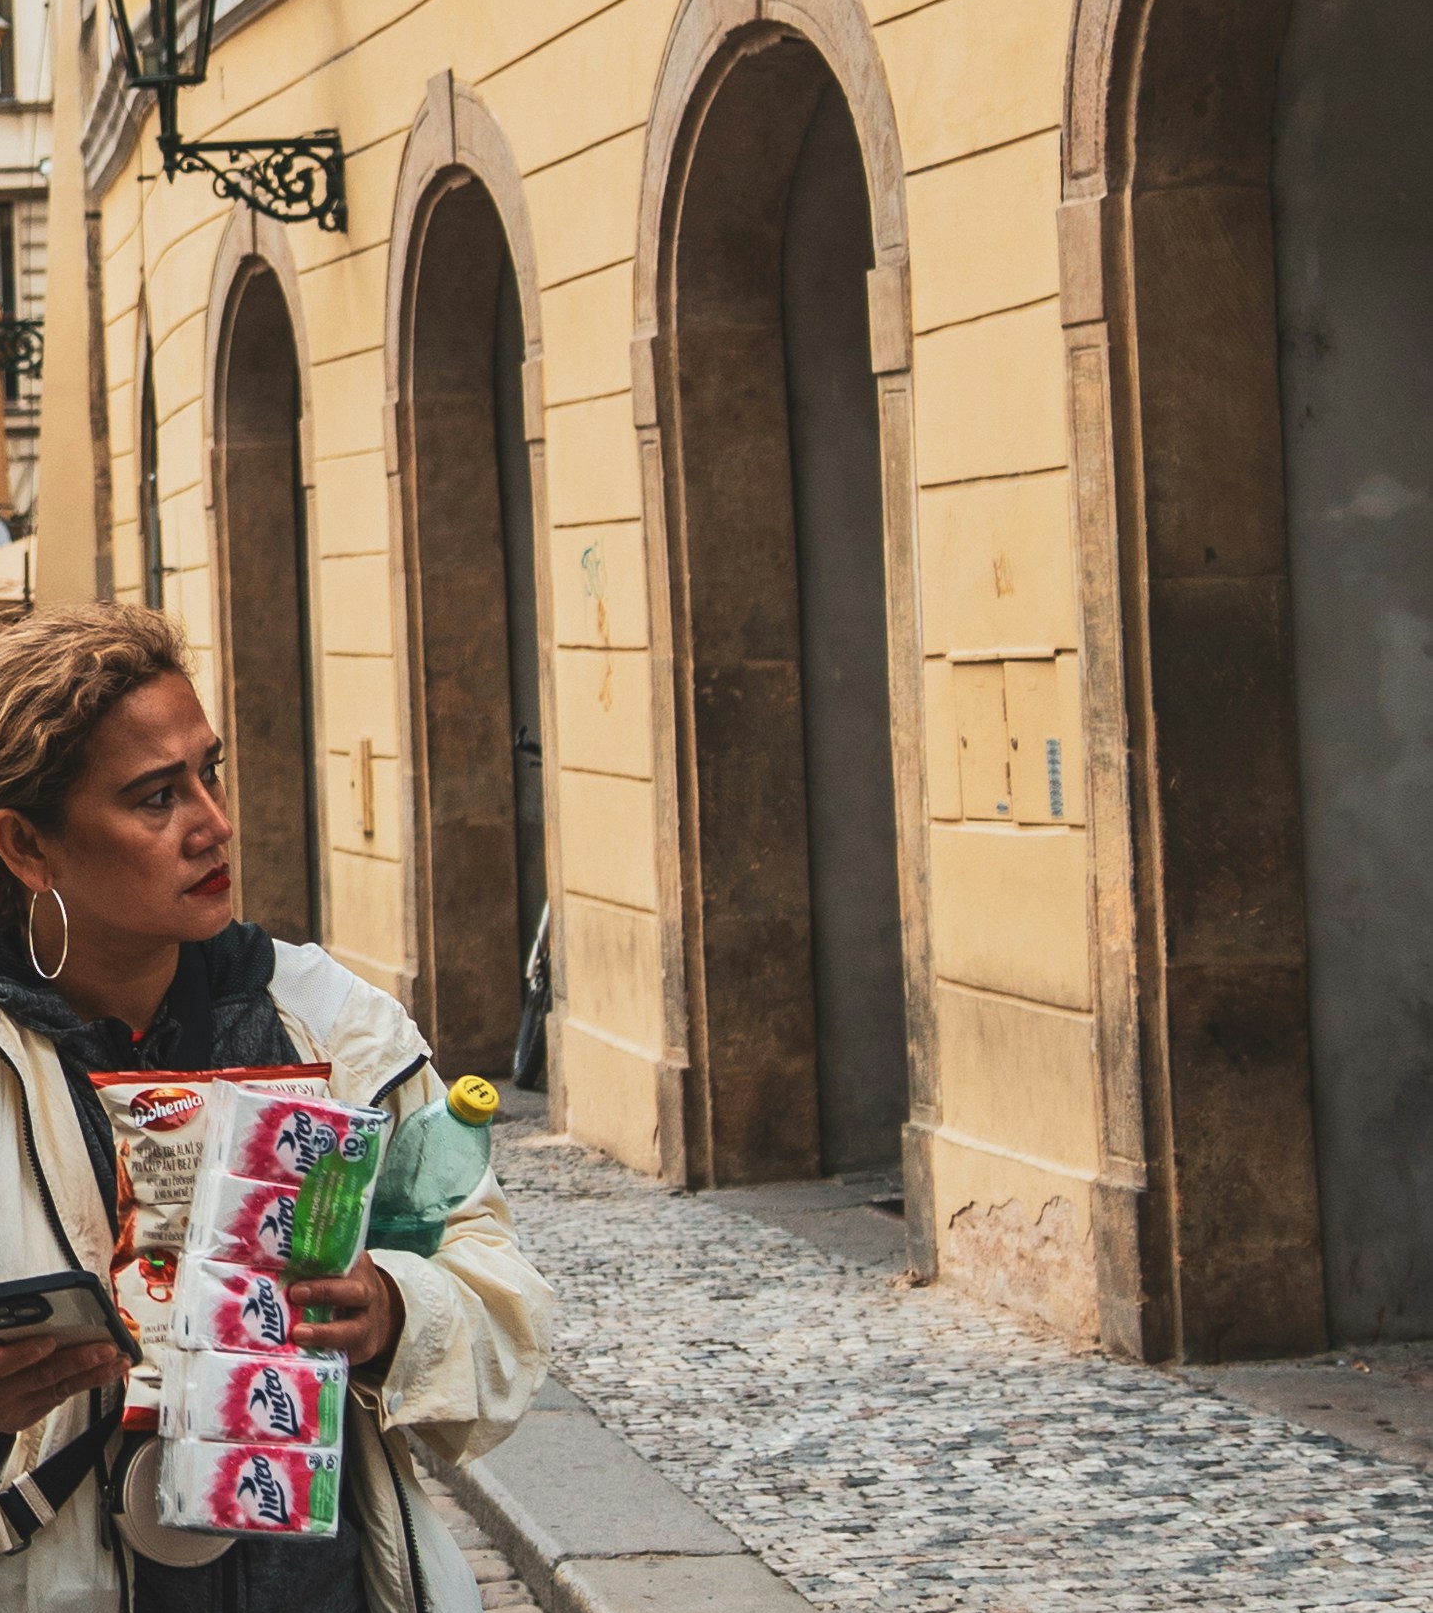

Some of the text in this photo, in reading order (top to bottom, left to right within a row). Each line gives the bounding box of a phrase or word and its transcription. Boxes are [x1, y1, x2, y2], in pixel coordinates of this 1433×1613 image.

[133, 1094, 205, 1129] Bohemia
[294, 1110, 320, 1175] Linteo
[342, 1137, 359, 1157] 10
[276, 1195, 295, 1259] Linteo
[257, 1277, 286, 1345] Linteo
[261, 1367, 301, 1437] Linteo
[251, 1455, 290, 1525] Linteo
